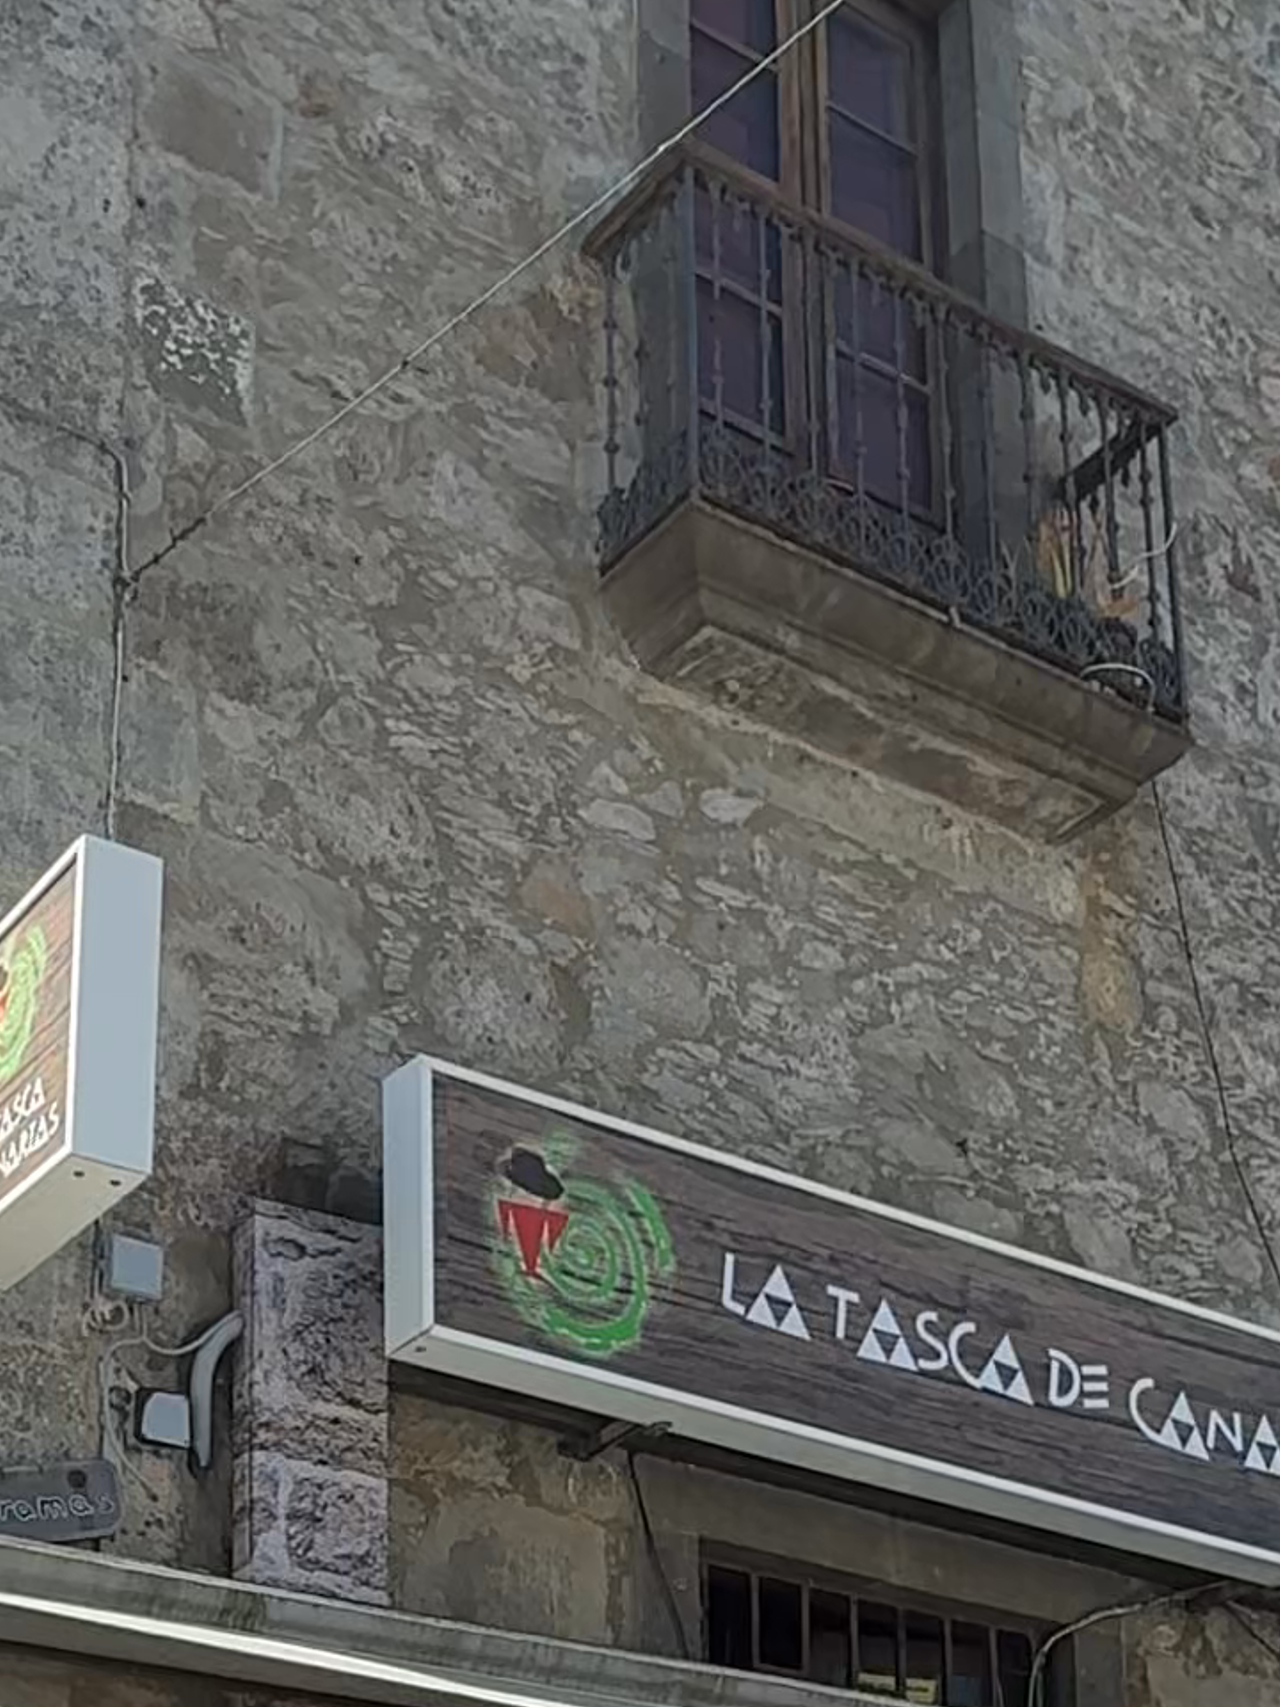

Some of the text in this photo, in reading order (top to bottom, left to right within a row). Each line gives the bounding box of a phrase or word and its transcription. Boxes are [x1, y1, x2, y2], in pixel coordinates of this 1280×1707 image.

[721, 1252, 812, 1341] LA
[824, 1283, 1034, 1407] TASCA
[1048, 1347, 1109, 1410] DE
